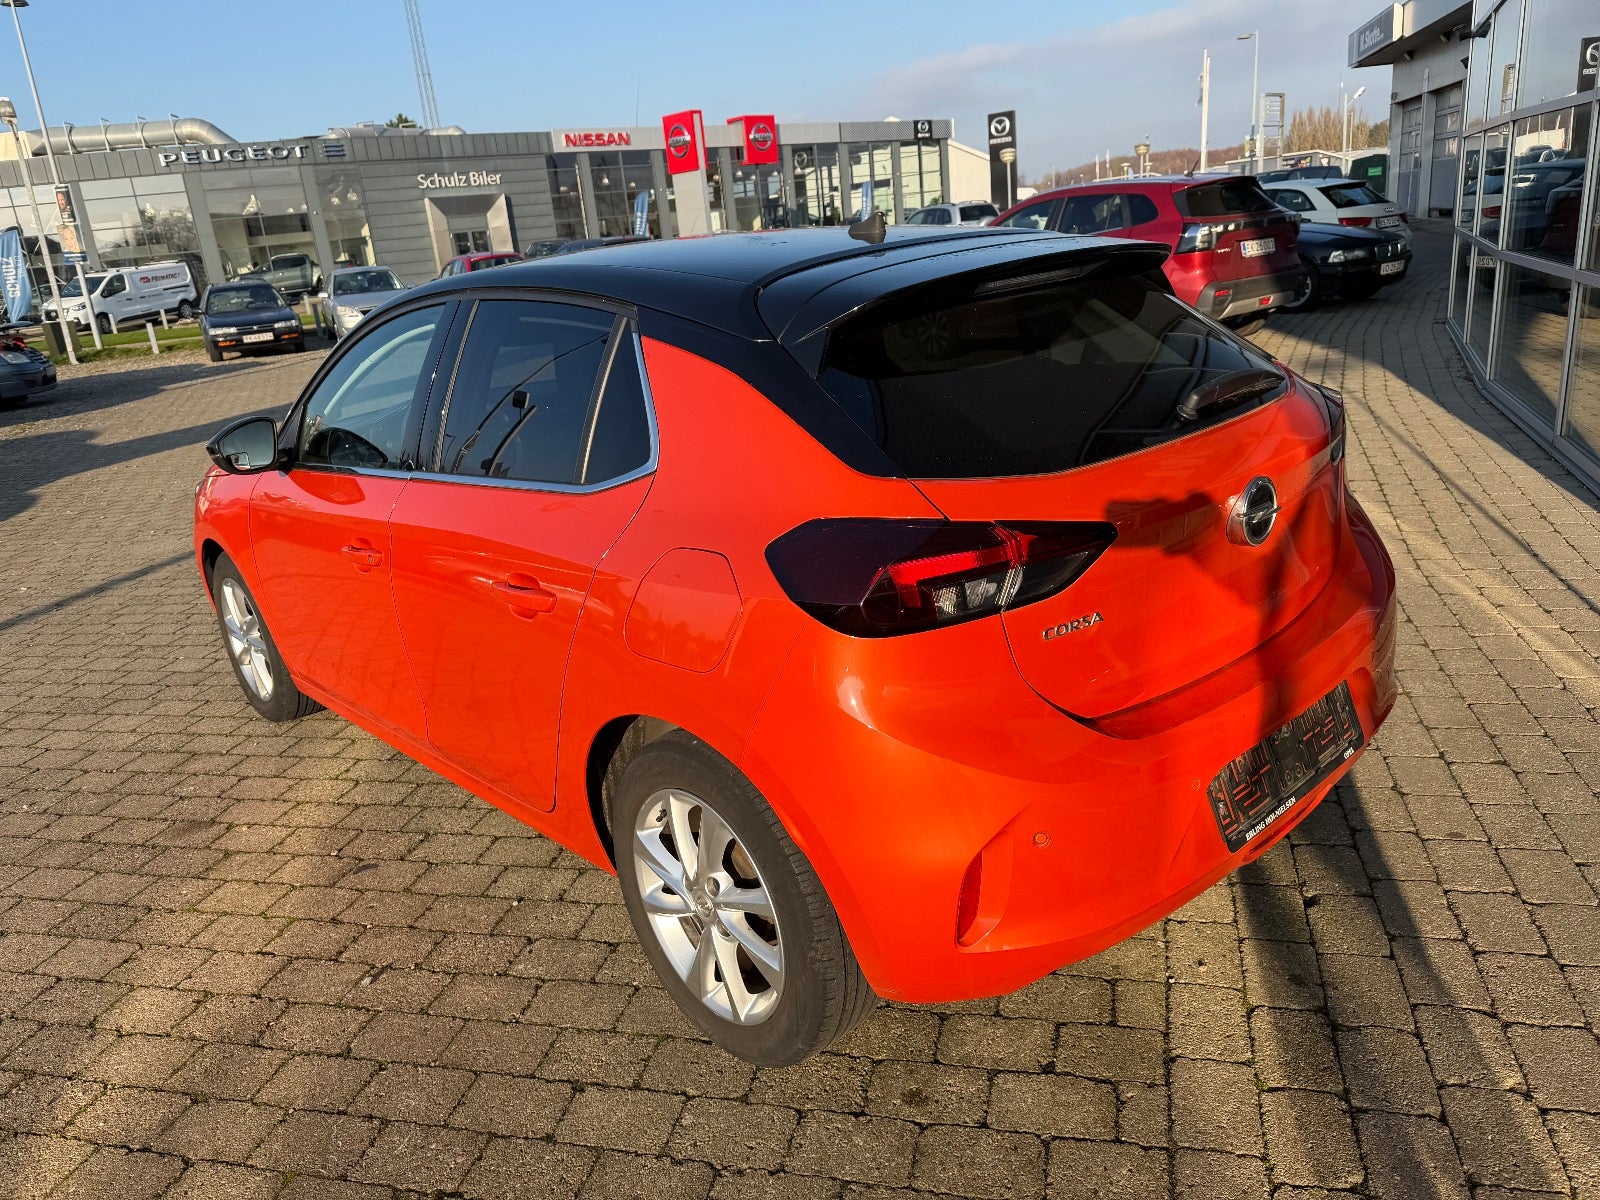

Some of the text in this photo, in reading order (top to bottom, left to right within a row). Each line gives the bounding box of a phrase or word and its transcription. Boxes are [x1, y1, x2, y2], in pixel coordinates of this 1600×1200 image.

[564, 131, 632, 147] NISSAN
[158, 145, 309, 167] PEUGEOT
[417, 170, 502, 189] Schulz Biler
[1, 256, 20, 298] SCHULZ
[1042, 611, 1104, 640] CORSA
[1245, 821, 1266, 841] ERLING
